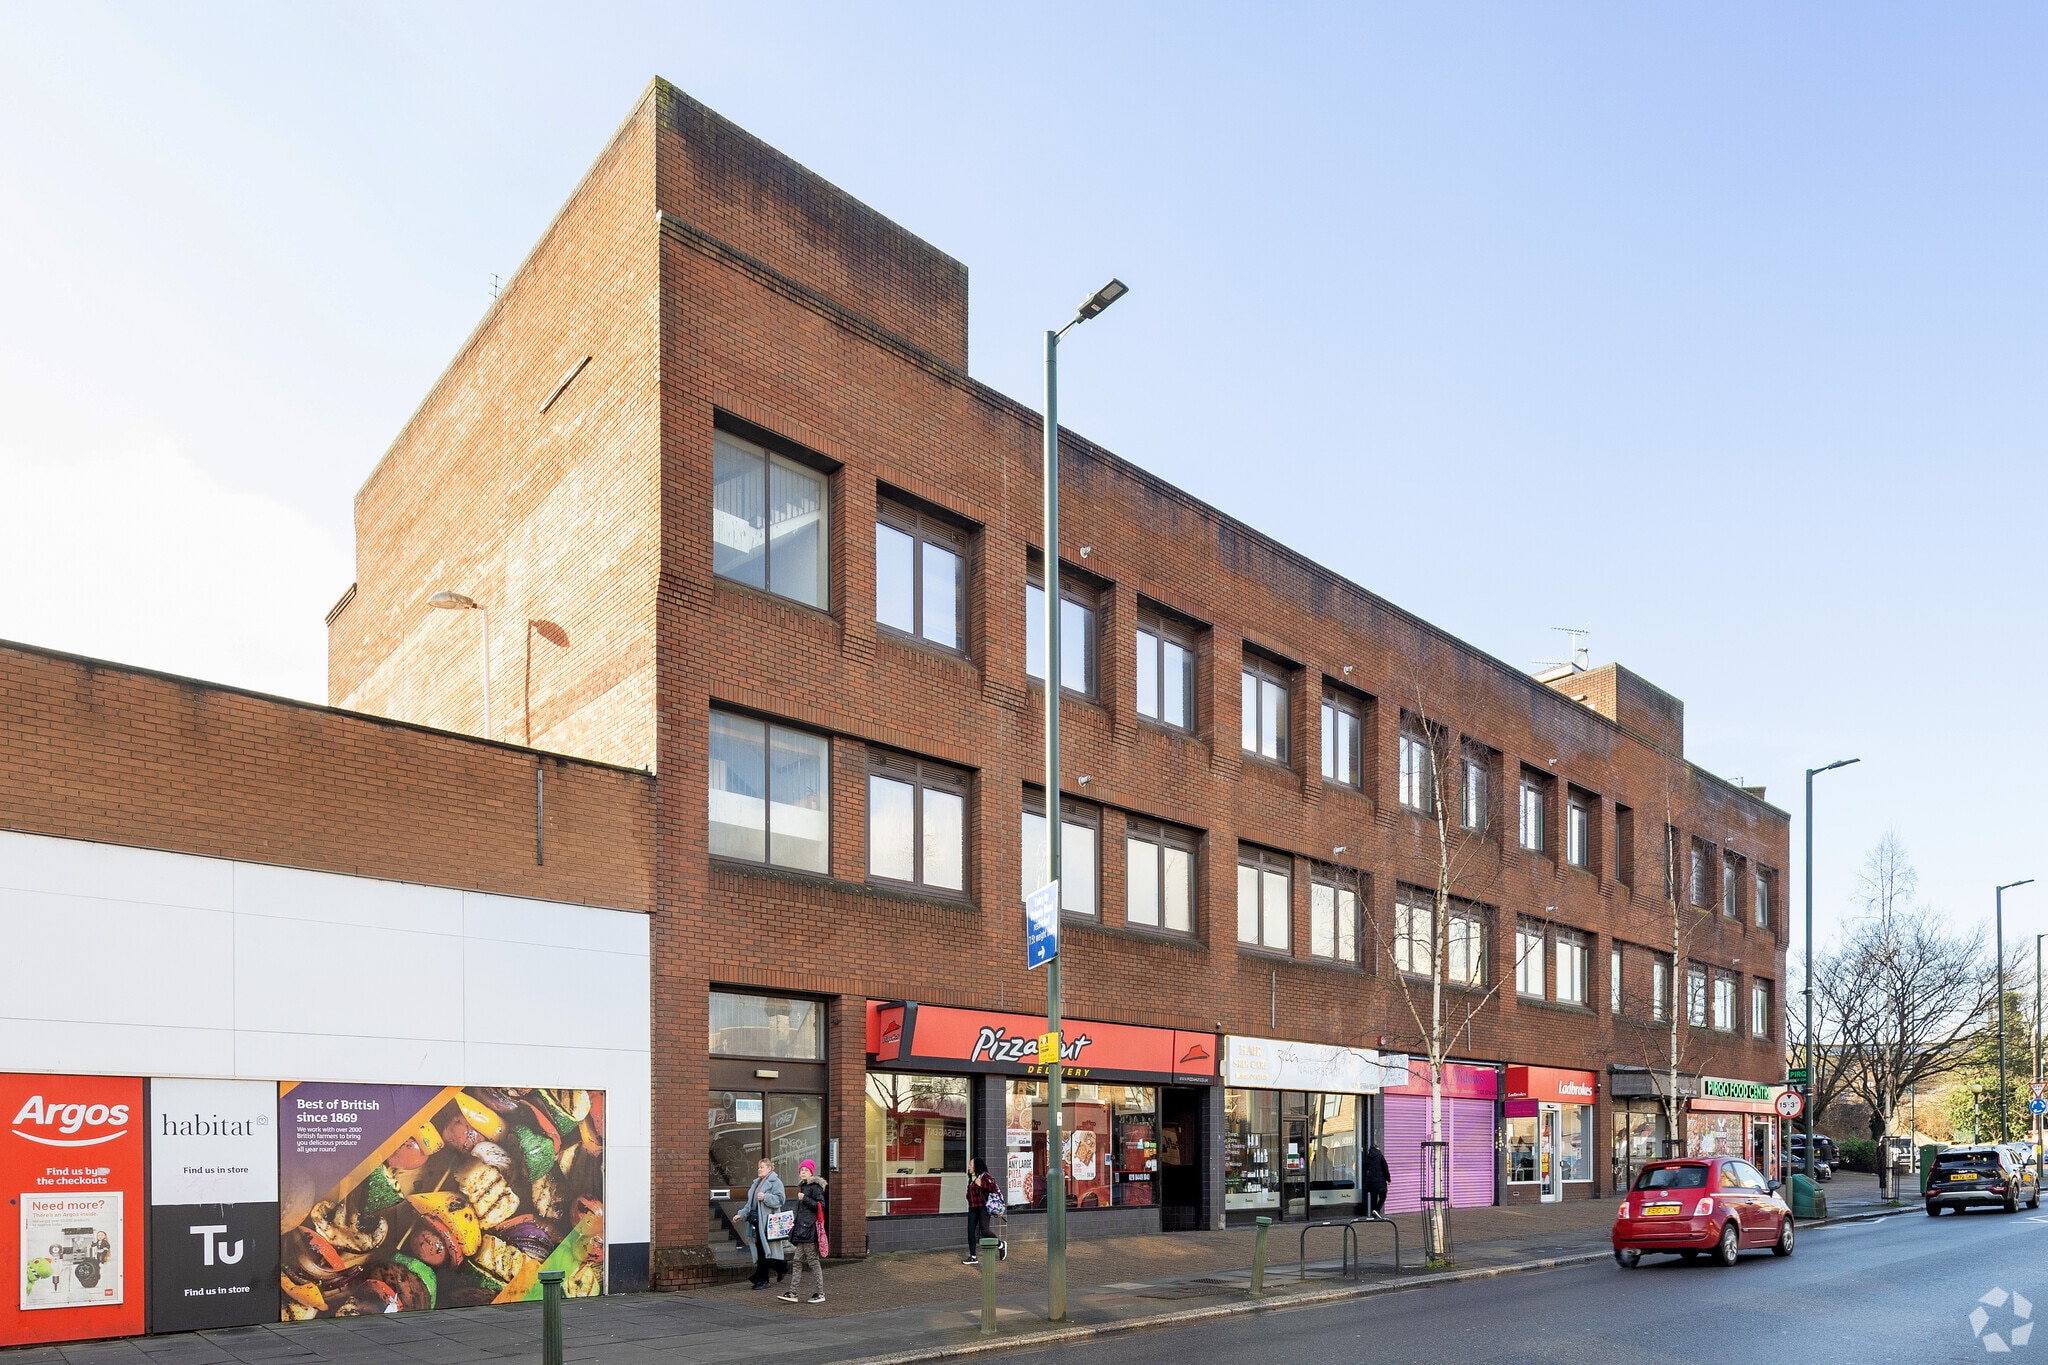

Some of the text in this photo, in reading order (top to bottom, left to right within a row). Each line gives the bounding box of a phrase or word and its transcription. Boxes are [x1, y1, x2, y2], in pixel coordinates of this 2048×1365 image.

[971, 1027, 1092, 1063] Pizza ut
[1027, 1065, 1090, 1077] DELVERY
[1558, 1080, 1592, 1096] Ladbrokes
[1730, 1083, 1748, 1098] FOOD
[296, 1099, 379, 1110] Best of British
[12, 1095, 130, 1134] Argos
[296, 1112, 358, 1122] since 1869
[162, 1113, 254, 1136] habitat
[1008, 1159, 1032, 1168] ANY LARGE
[46, 1167, 69, 1175] Find
[85, 1167, 98, 1176] by
[183, 1166, 202, 1174] Find
[1008, 1168, 1021, 1178] PIZZA
[37, 1176, 107, 1185] the checkouts
[32, 1200, 105, 1211] Need more?
[190, 1224, 244, 1266] Tu
[184, 1288, 204, 1296] Find
[218, 1286, 226, 1294] in
